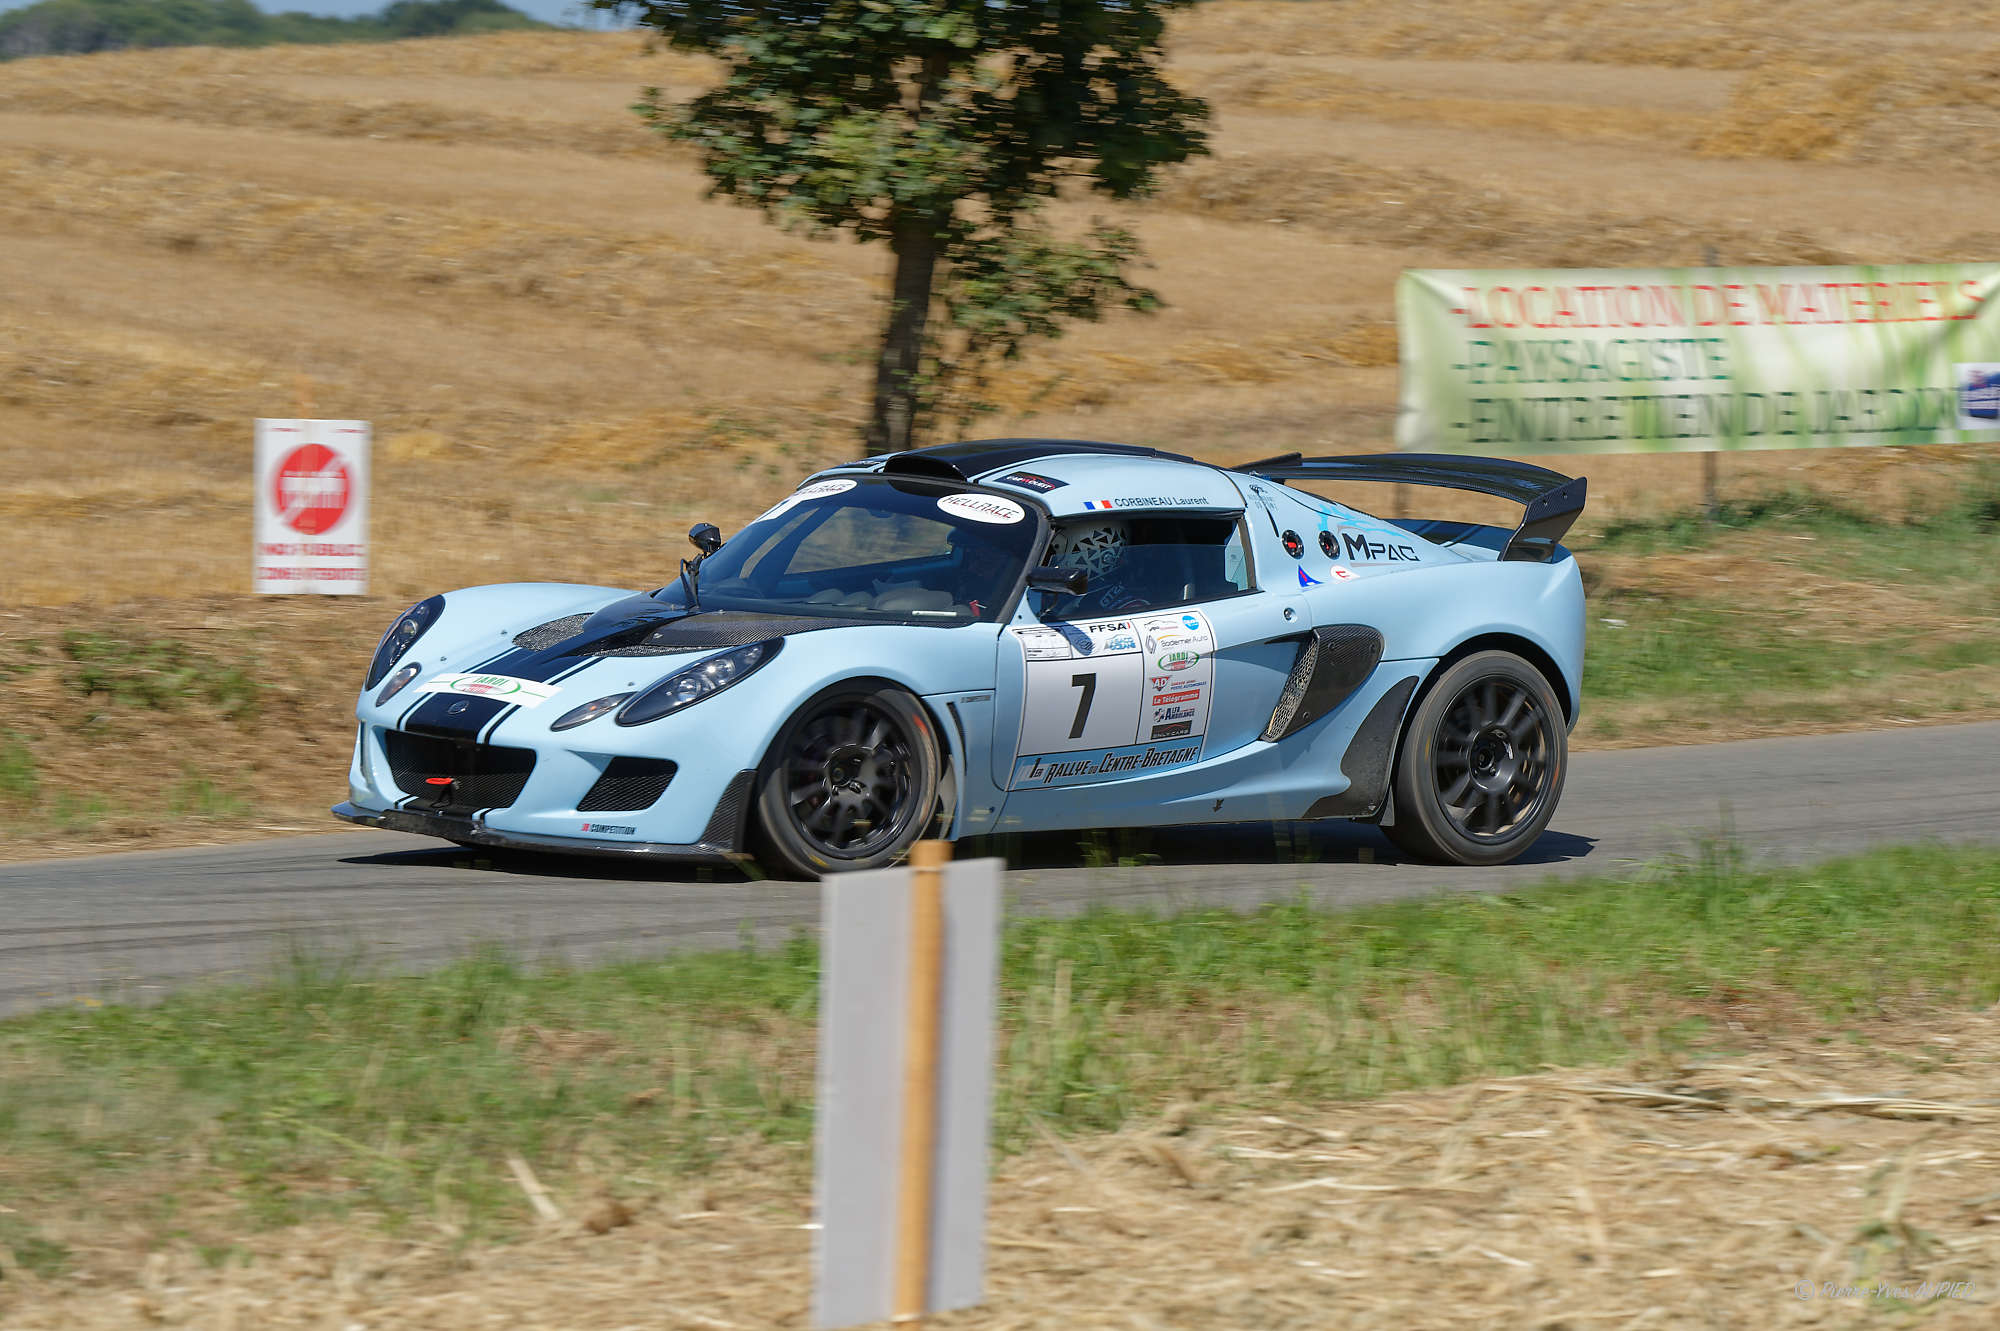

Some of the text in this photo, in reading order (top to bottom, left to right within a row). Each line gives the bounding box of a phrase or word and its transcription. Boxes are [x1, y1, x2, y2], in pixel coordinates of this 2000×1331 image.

[1691, 284, 1752, 326] DE
[942, 496, 1020, 519] HELLRACE
[1114, 496, 1209, 507] CORBINEAU Laurent
[1089, 622, 1127, 633] FFSA
[1153, 678, 1168, 688] AD
[1068, 673, 1097, 739] 7
[1153, 697, 1161, 705] Le
[1044, 760, 1091, 783] RALLYE
[1099, 746, 1198, 773] CENTRE-BRETAGNE
